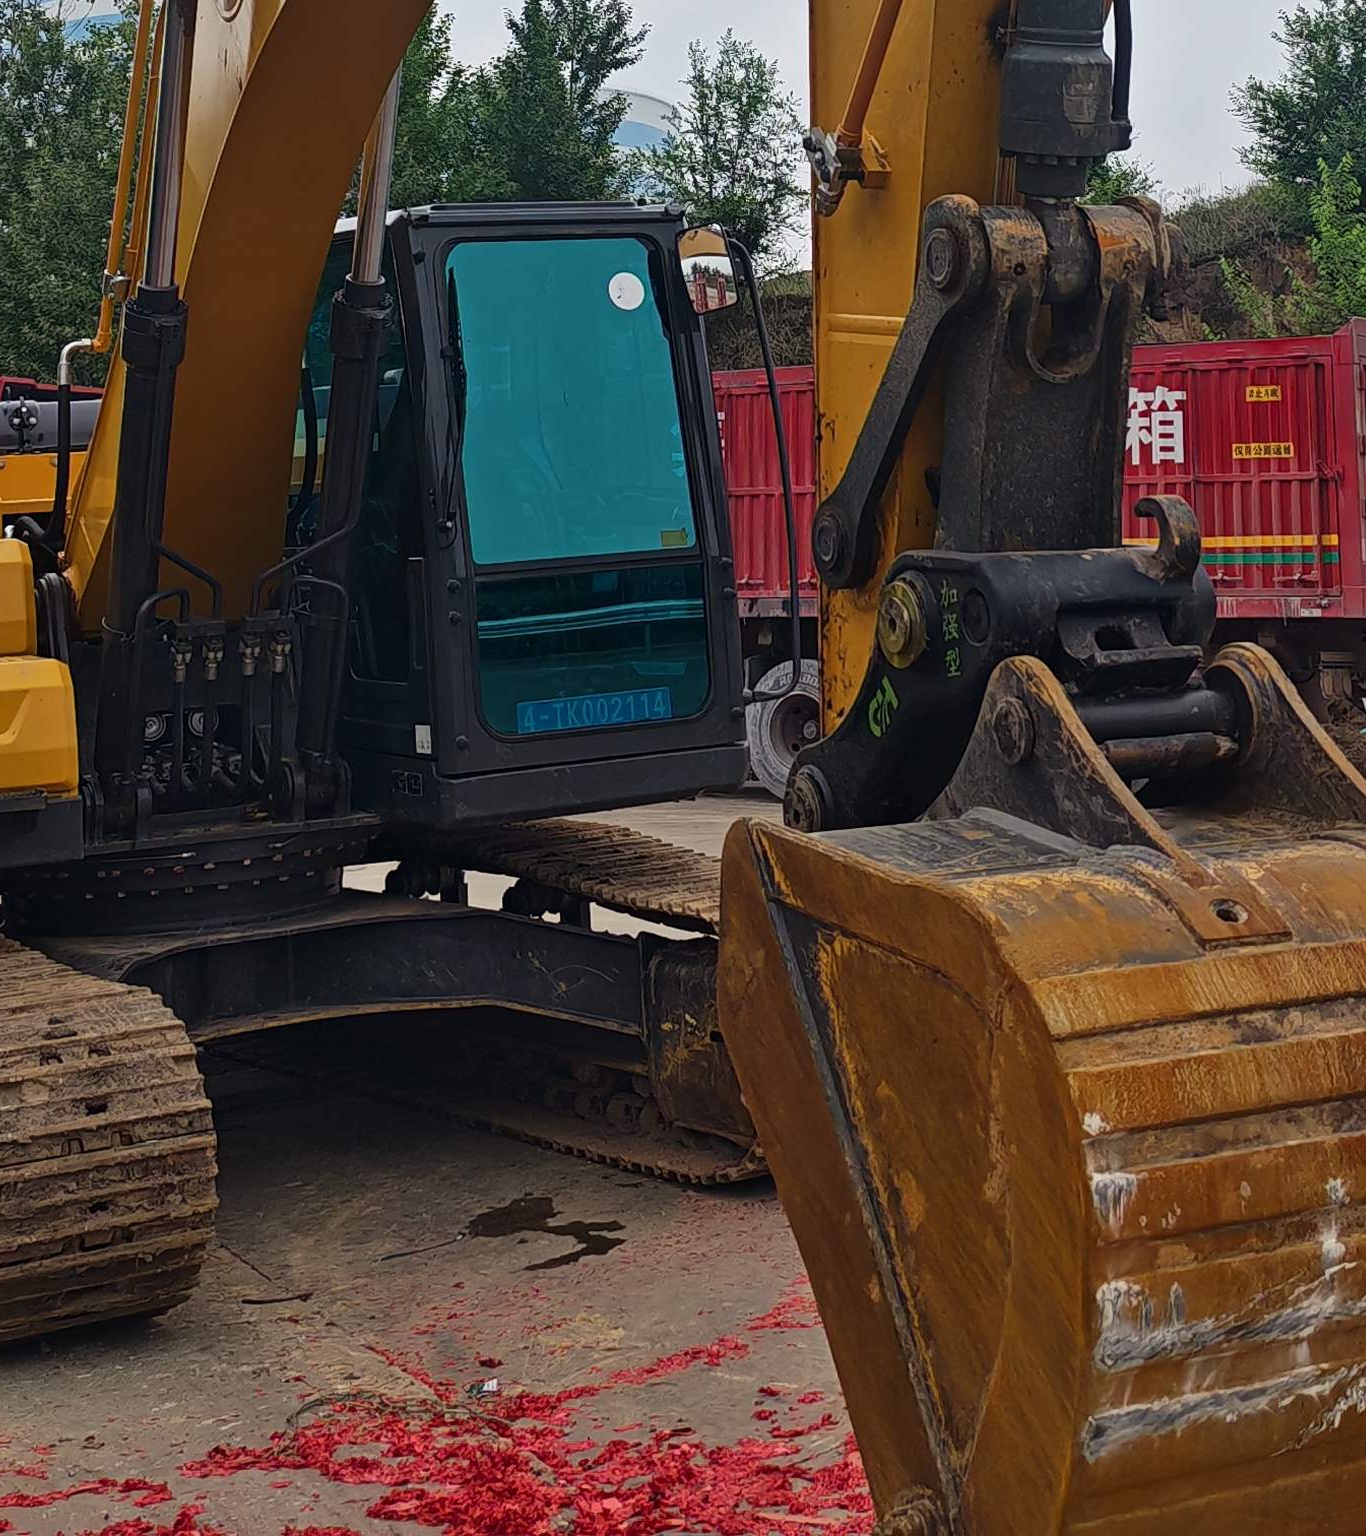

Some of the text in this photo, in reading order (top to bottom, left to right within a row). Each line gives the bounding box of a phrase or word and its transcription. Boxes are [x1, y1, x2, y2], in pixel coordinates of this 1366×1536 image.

[1125, 385, 1186, 466] 箱
[940, 580, 962, 678] 加强型
[523, 691, 667, 732] 4-TK002114
